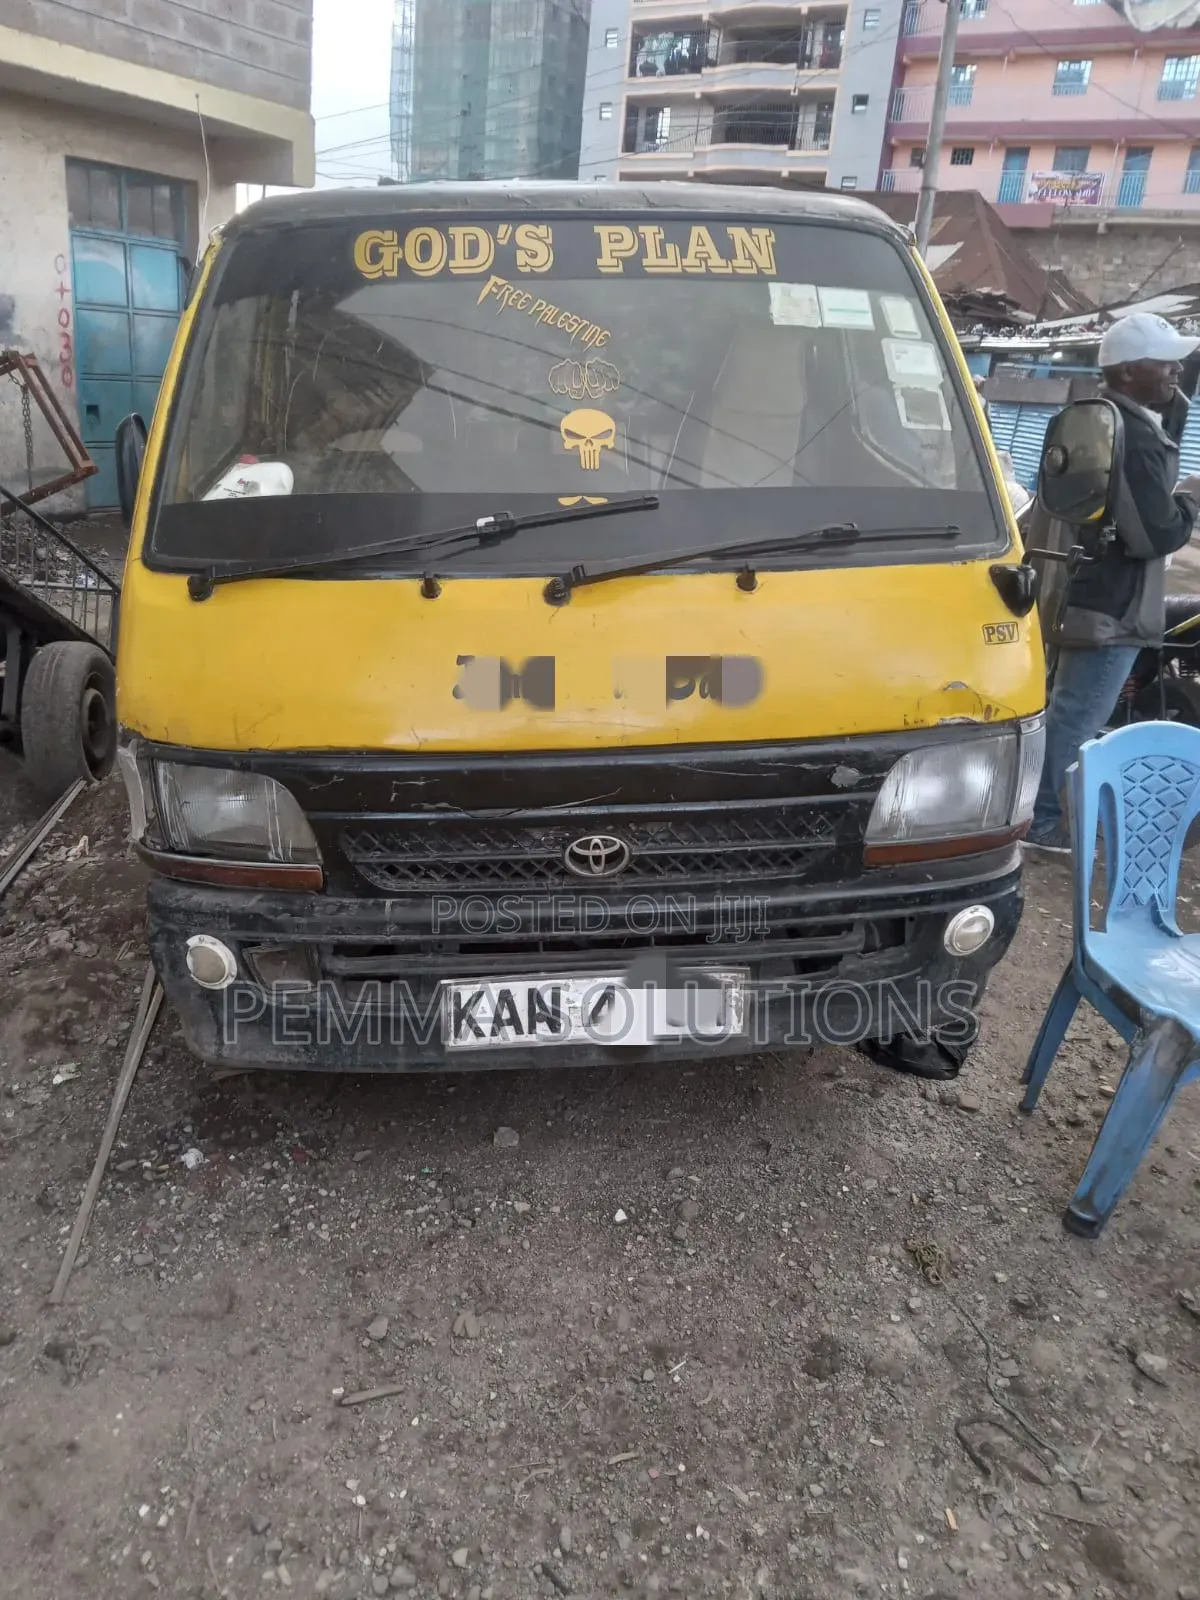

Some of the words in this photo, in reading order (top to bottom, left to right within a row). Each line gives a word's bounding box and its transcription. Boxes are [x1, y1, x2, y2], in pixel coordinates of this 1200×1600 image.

[354, 224, 554, 279] GOD'S
[593, 225, 777, 275] PLAN
[984, 623, 1016, 643] PSV
[452, 985, 562, 1039] KAN
